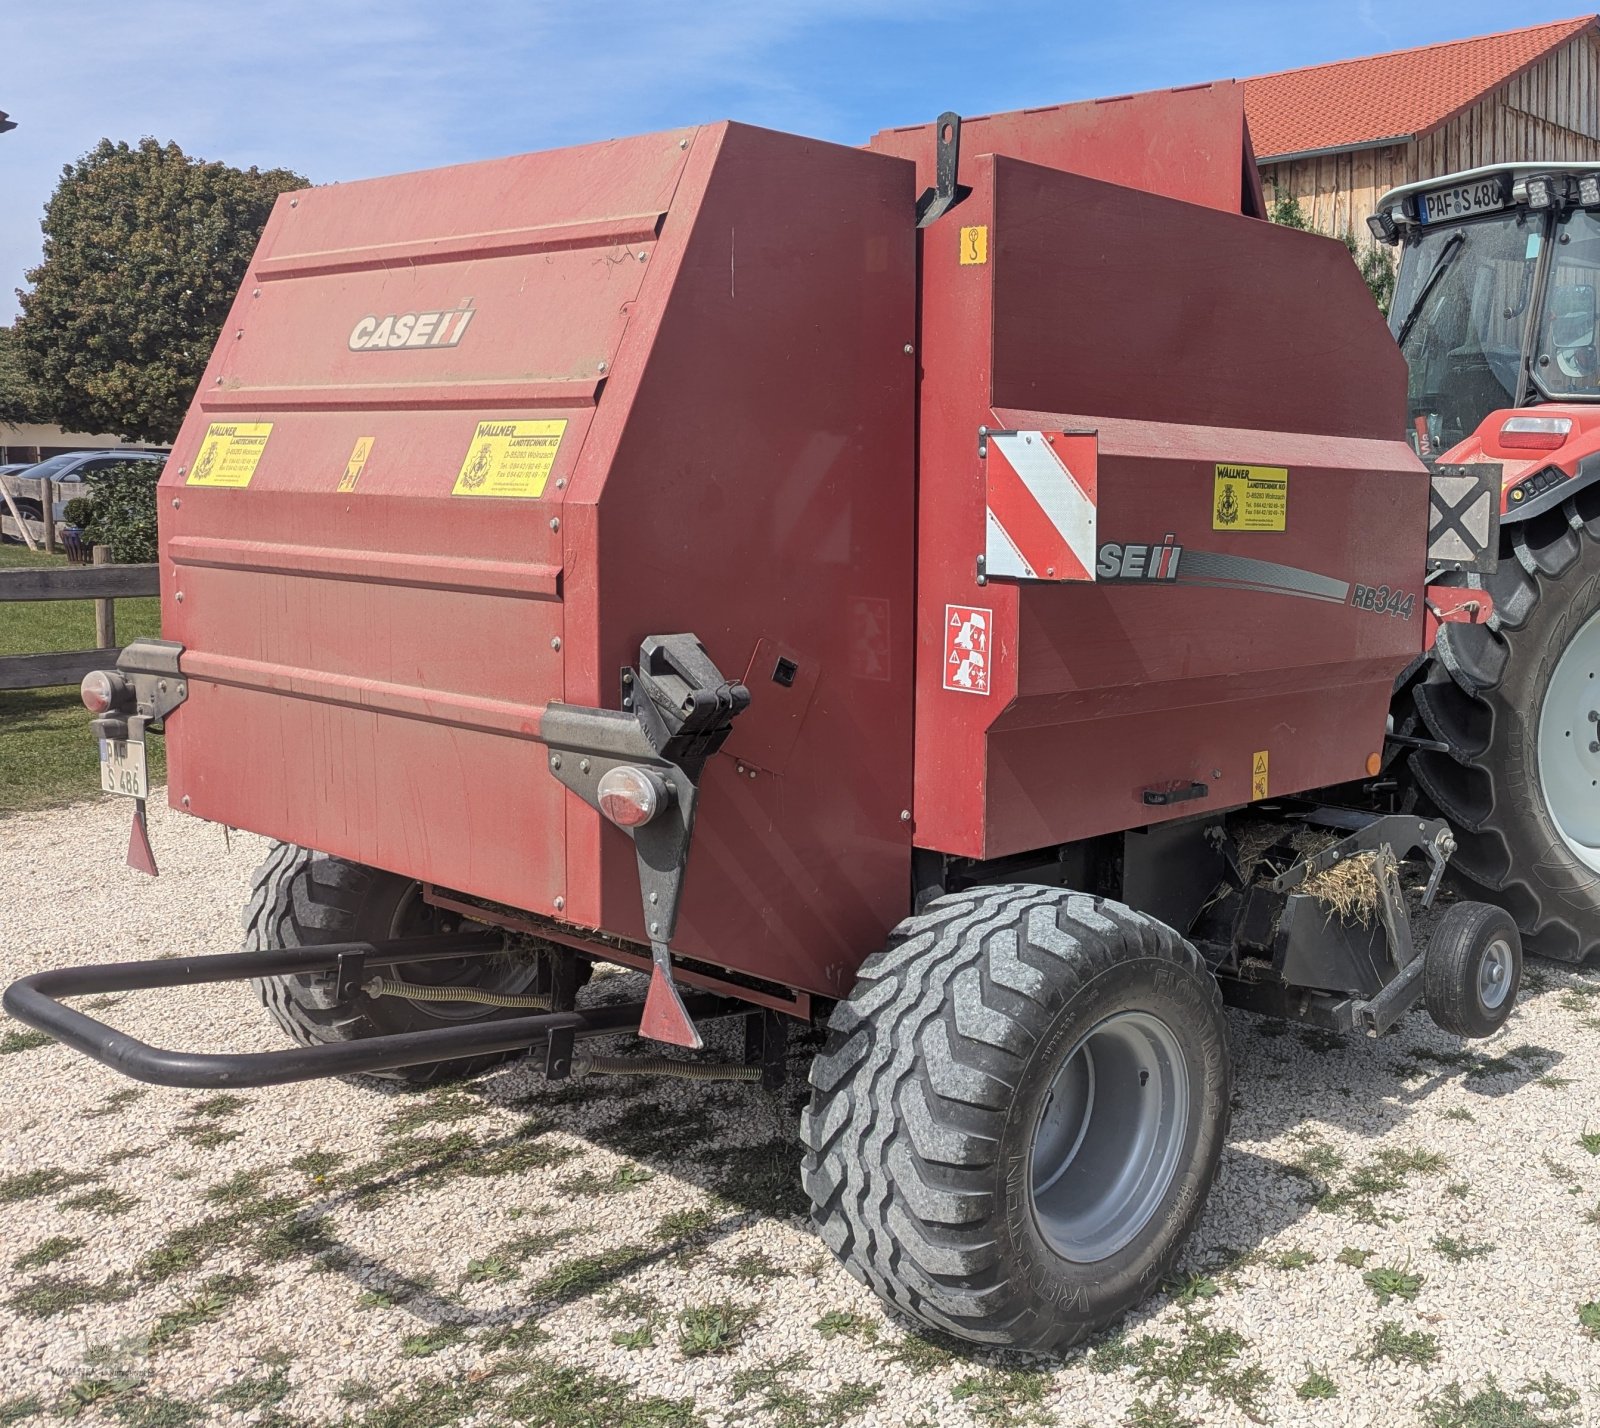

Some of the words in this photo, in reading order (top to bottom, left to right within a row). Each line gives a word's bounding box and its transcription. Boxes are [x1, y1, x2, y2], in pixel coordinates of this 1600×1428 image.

[1426, 192, 1452, 219] PAF
[1461, 189, 1472, 211] S
[208, 425, 238, 437] WALLNER
[477, 424, 517, 439] WALLNER
[508, 439, 547, 447] LANDTECHNIK
[548, 438, 559, 447] KG
[1217, 466, 1250, 481] WALLNER
[1247, 482, 1277, 490] LANDTECHNIK
[1350, 583, 1416, 621] RB344
[108, 768, 115, 791] S
[120, 769, 139, 795] 486
